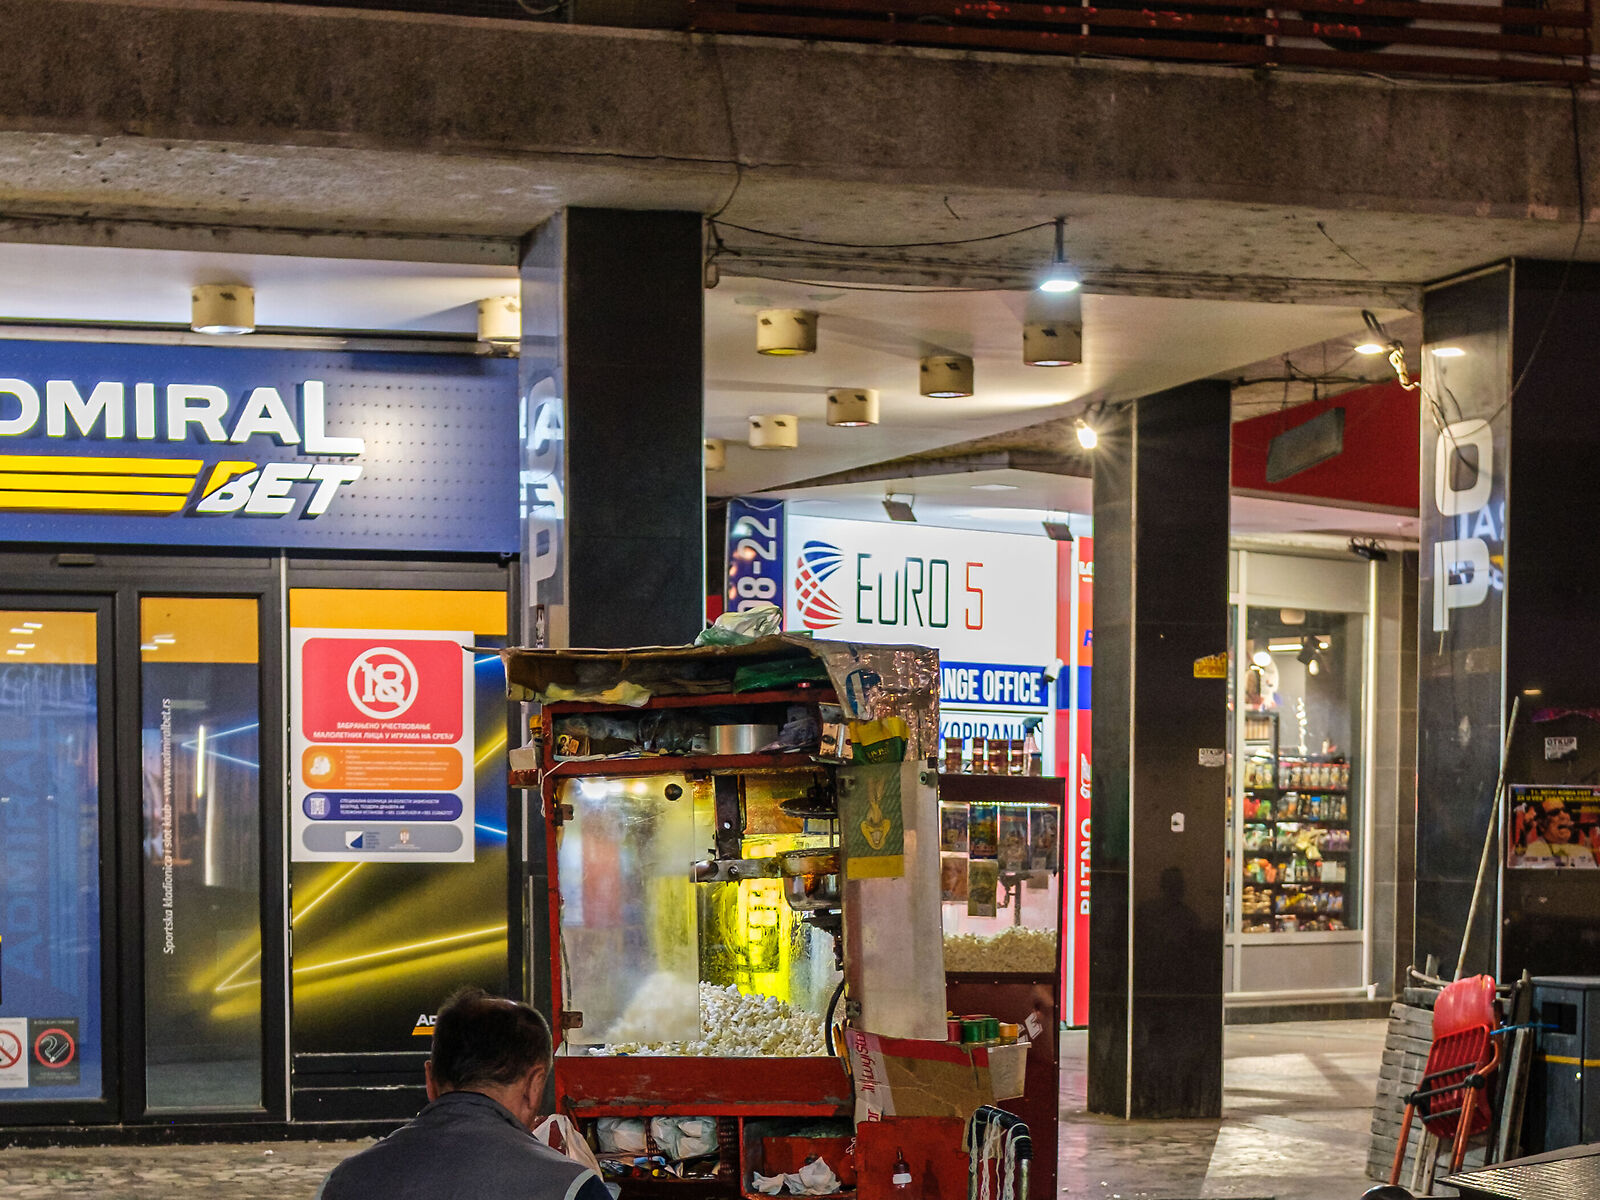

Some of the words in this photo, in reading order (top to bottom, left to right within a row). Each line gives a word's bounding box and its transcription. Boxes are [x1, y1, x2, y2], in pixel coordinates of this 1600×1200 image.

[0, 378, 365, 455] DMIRAL
[195, 460, 364, 515] BET
[965, 562, 984, 631] 5
[362, 663, 405, 703] 18
[982, 669, 1042, 704] OFFICE
[939, 721, 1025, 750] KOPIRANJ
